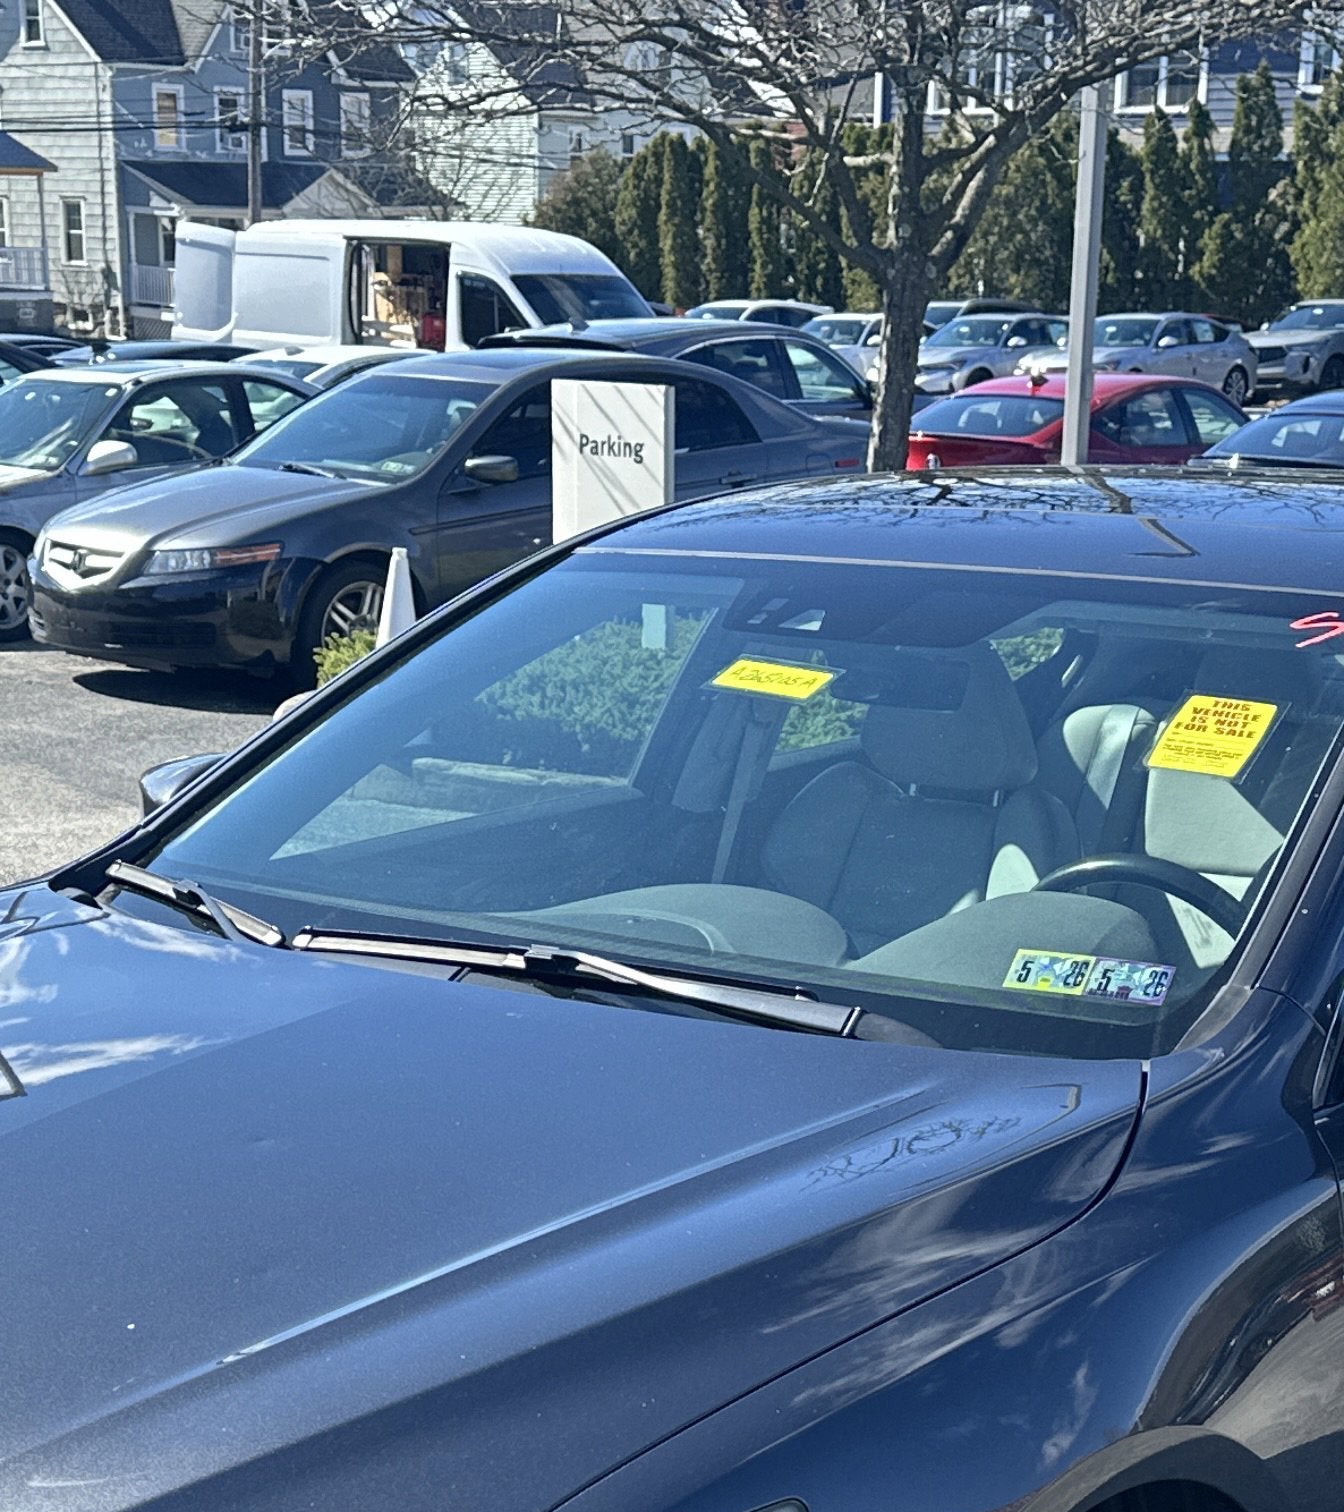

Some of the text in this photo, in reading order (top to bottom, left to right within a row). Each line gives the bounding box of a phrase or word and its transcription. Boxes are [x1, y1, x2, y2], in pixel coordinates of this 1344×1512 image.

[579, 433, 645, 464] Parking
[1192, 706, 1261, 722] VEHICLE
[1212, 700, 1252, 711] THIS
[1174, 721, 1256, 739] FOR SALE
[1190, 716, 1251, 729] IS NOT
[1016, 960, 1090, 987] 5 26
[1096, 968, 1169, 997] 5 26
